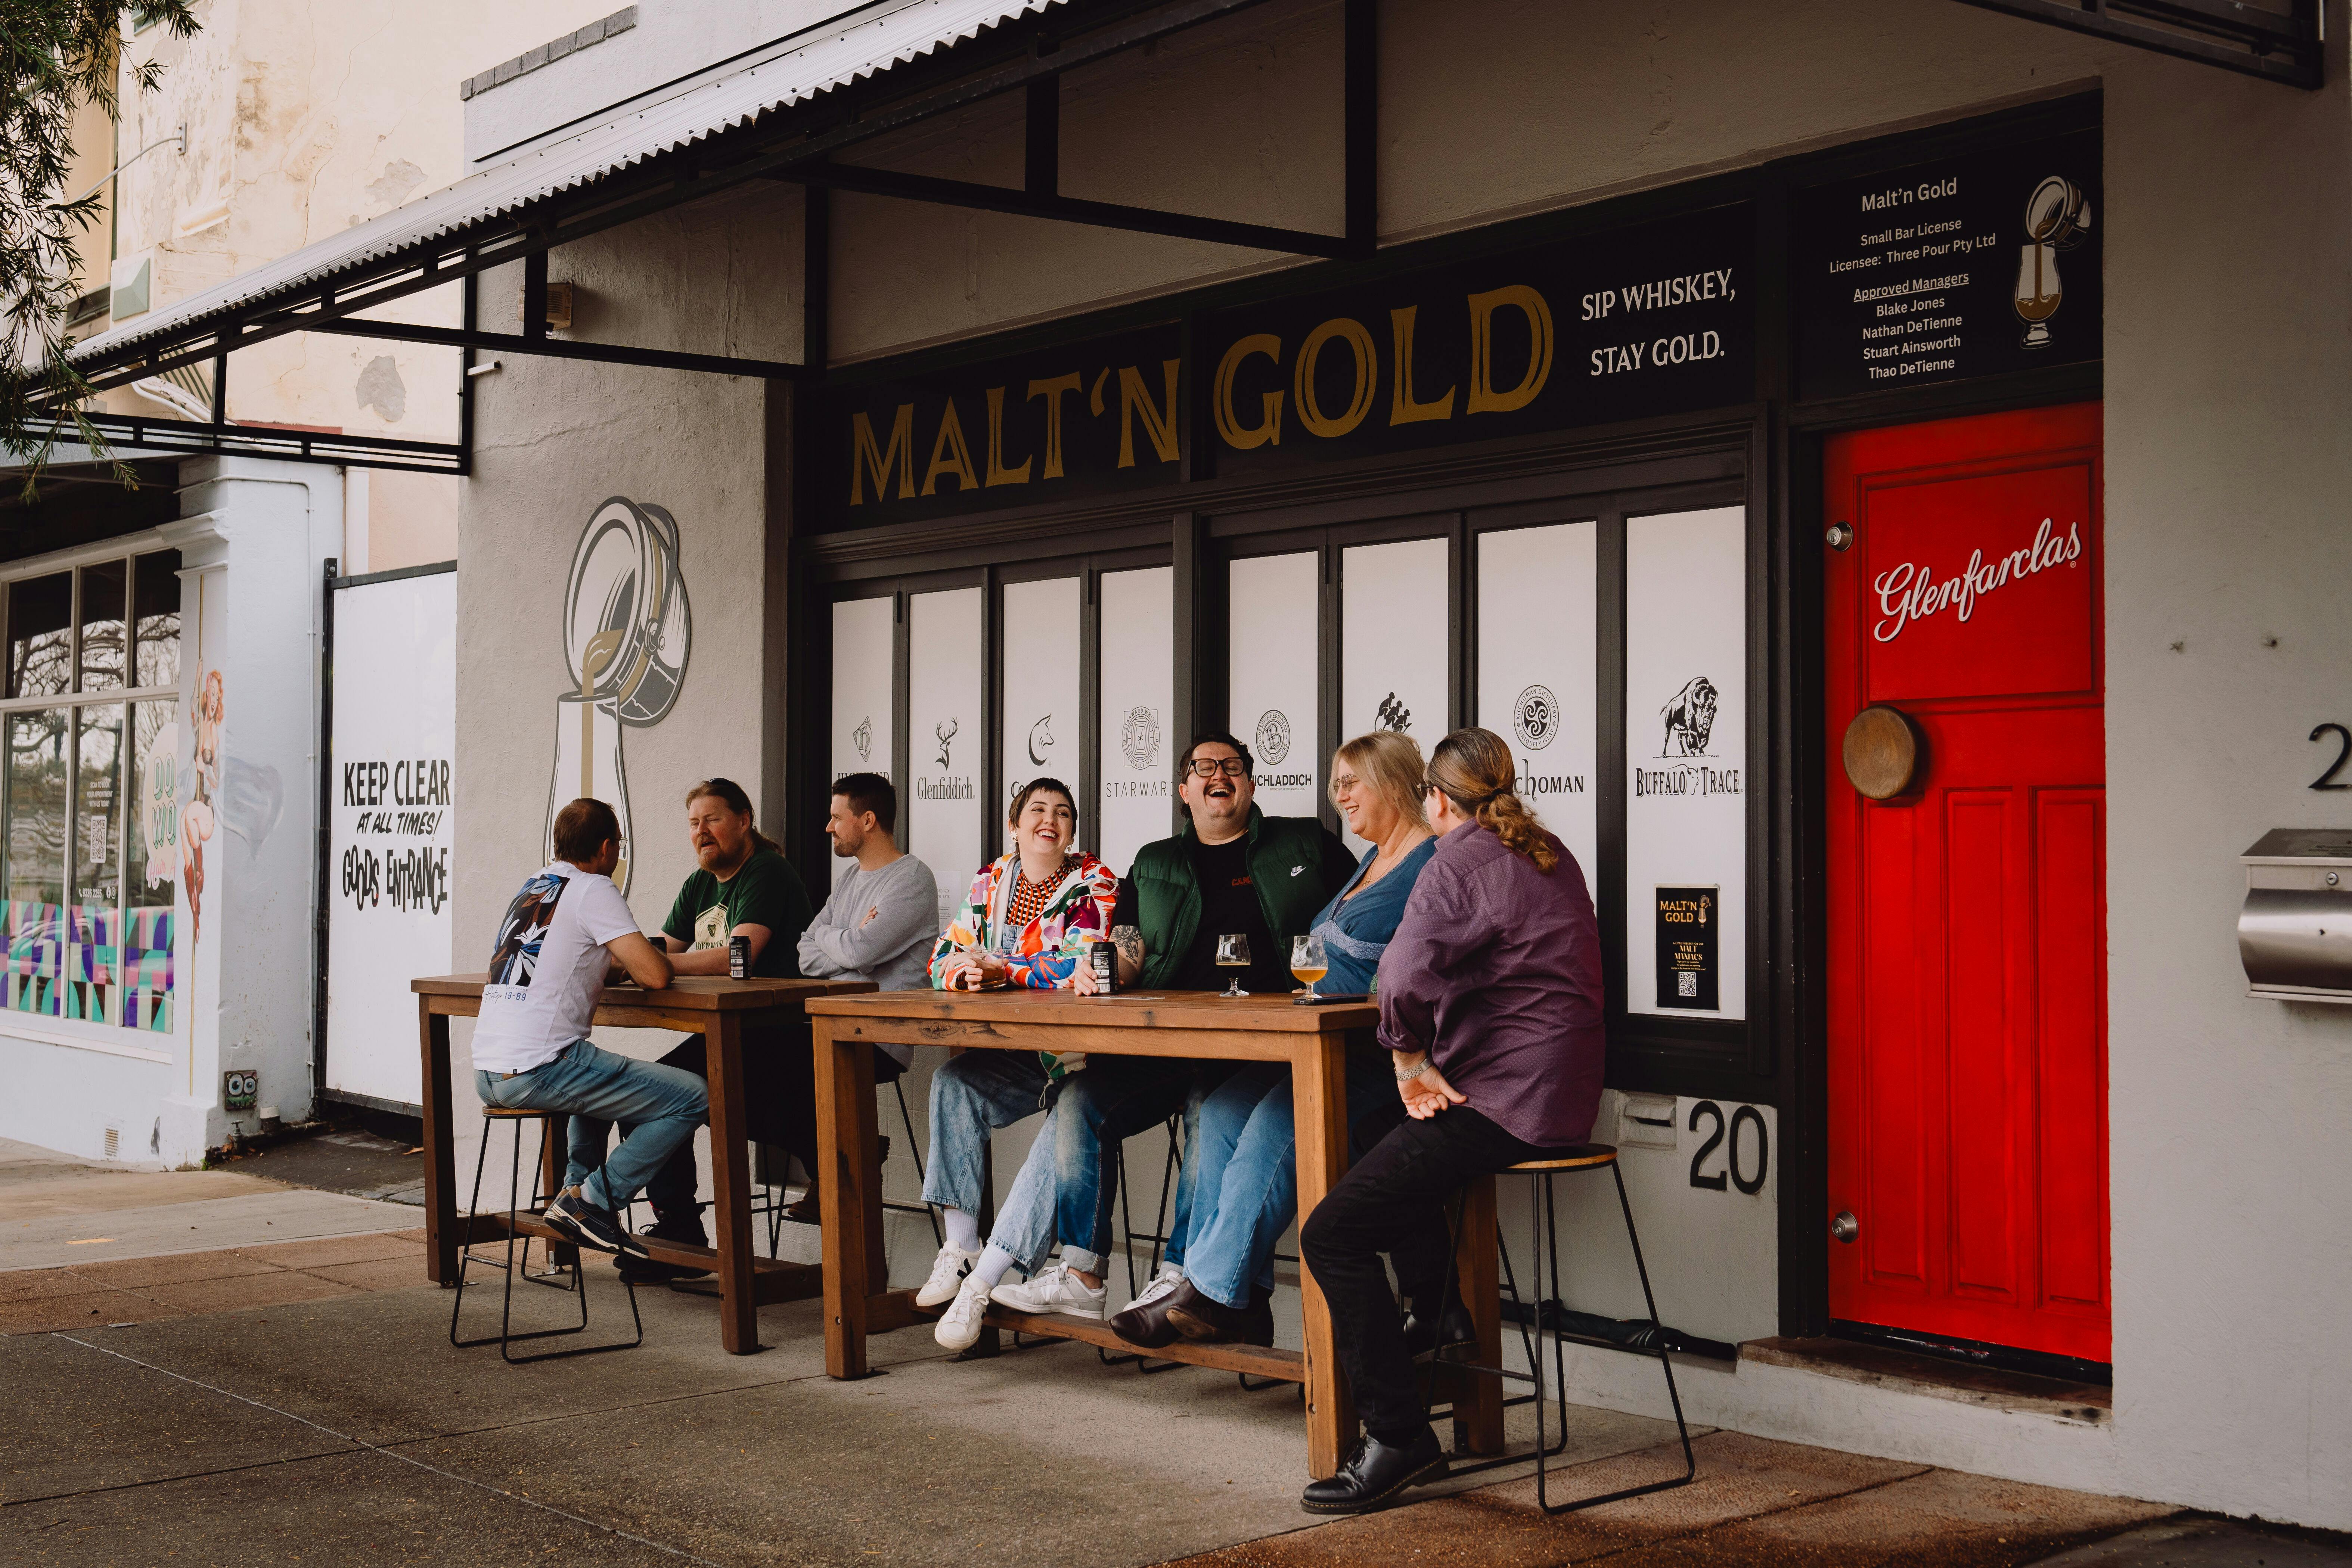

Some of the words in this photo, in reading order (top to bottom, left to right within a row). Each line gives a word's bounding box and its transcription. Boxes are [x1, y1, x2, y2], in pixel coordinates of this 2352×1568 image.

[1862, 188, 1912, 211] Malt'n
[1918, 178, 1957, 200] Gold
[1861, 229, 1892, 246] Small
[1895, 226, 1915, 240] Bar
[1918, 220, 1962, 236] License
[1830, 256, 1881, 273] Licensee:
[1887, 248, 1920, 263] Three
[1923, 244, 1951, 257] Pour
[1953, 240, 1972, 254] Pty
[1976, 233, 1996, 248] Ltd
[1582, 291, 1615, 320] SIP
[1622, 268, 1735, 313] WHISKEY,
[1854, 282, 1909, 302] Approved
[1912, 273, 1969, 291] Managers
[1877, 302, 1908, 317] Blake
[1910, 297, 1945, 312] Jones
[1863, 323, 1904, 339] Nathan
[1907, 316, 1962, 332] DeTienne
[1591, 342, 1645, 376] STAY
[1653, 331, 1724, 366] GOLD.
[1864, 345, 1899, 359] Stuart
[1902, 335, 1961, 353] Ainsworth
[1869, 366, 1897, 379] Thao
[1900, 358, 1955, 374] DeTienne
[850, 357, 1180, 506] MALT'N
[1213, 285, 1554, 450] GOLD
[1874, 518, 2082, 642] Glenfarclas
[1124, 708, 1143, 730] STARWARD
[1145, 710, 1158, 729] WHISKY
[1517, 689, 1536, 720] KILCHOMAN
[1539, 689, 1556, 718] DISTILLERY
[1259, 715, 1269, 752] PROGRESSIVE
[1270, 714, 1288, 733] HEBRIDEAN
[1519, 730, 1541, 746] UNIQUELY
[1543, 729, 1554, 744] ISLAY
[1123, 740, 1144, 768] ELEMENTALLY
[1146, 739, 1158, 766] MATURED
[1270, 743, 1287, 761] DISTILLERS
[2308, 723, 2352, 790] 2
[153, 752, 177, 800] DO
[344, 762, 388, 806] KEEP
[394, 760, 450, 806] CLEAR
[918, 777, 973, 799] Glenfiddich
[1253, 774, 1312, 786] ICHLADDICH
[1636, 768, 1687, 798] BUFFALO
[1700, 767, 1740, 797] TRACE
[357, 812, 372, 834] AT
[372, 812, 392, 834] ALL
[397, 810, 443, 841] TIMES!
[148, 856, 165, 886] Hair
[343, 845, 379, 911] GOODS
[387, 846, 447, 915] ENTRANCE
[83, 888, 92, 898] 9336
[93, 888, 102, 898] 2255
[1660, 901, 1697, 911] MALT'N
[1665, 912, 1694, 922] GOLD
[505, 991, 526, 1001] 19-89
[1689, 1100, 1768, 1195] 20
